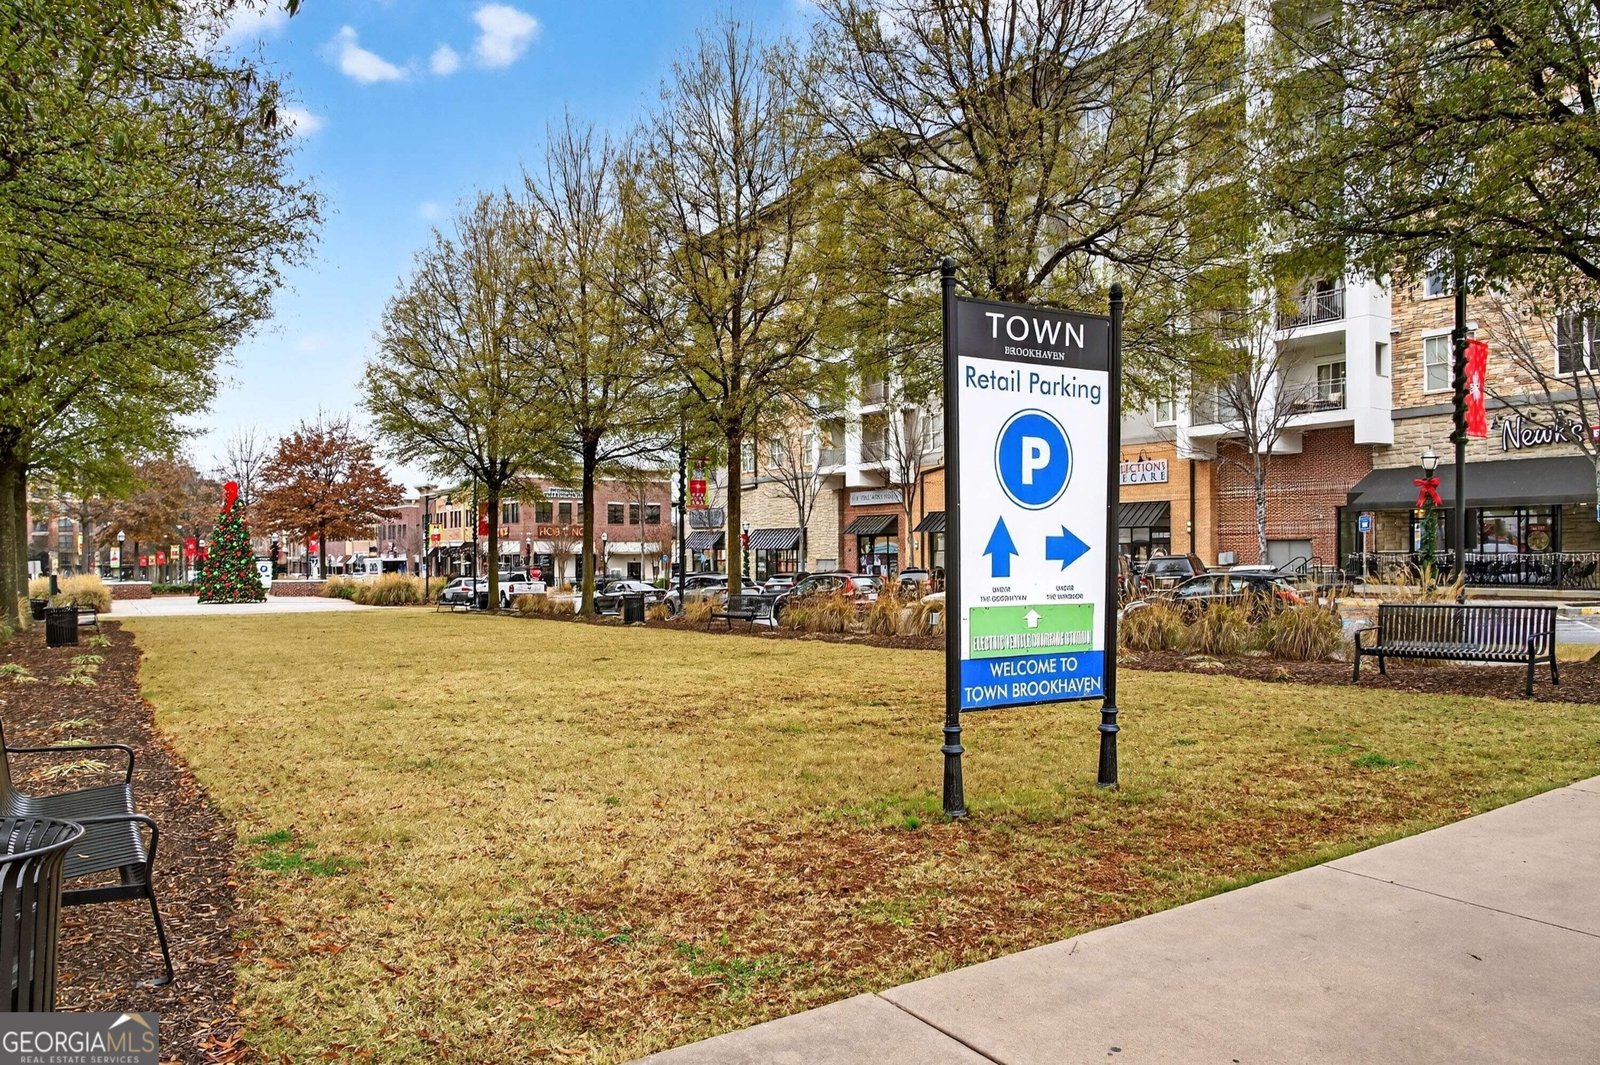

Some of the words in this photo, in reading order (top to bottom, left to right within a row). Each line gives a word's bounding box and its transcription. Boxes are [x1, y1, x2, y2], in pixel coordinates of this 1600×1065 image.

[985, 312, 1084, 348] TOWN
[1004, 346, 1065, 360] BROOKHAVEN
[965, 365, 1020, 392] Retail
[1029, 372, 1101, 405] Parking
[1502, 415, 1583, 452] Newk's
[1021, 435, 1051, 486] P
[1120, 461, 1166, 474] LECTIONS
[1122, 471, 1166, 483] ECARE
[990, 658, 1057, 678] WELCOME
[1060, 657, 1078, 672] TO
[964, 683, 1008, 703] TOWN
[1012, 676, 1101, 698] BROOKHAVEN
